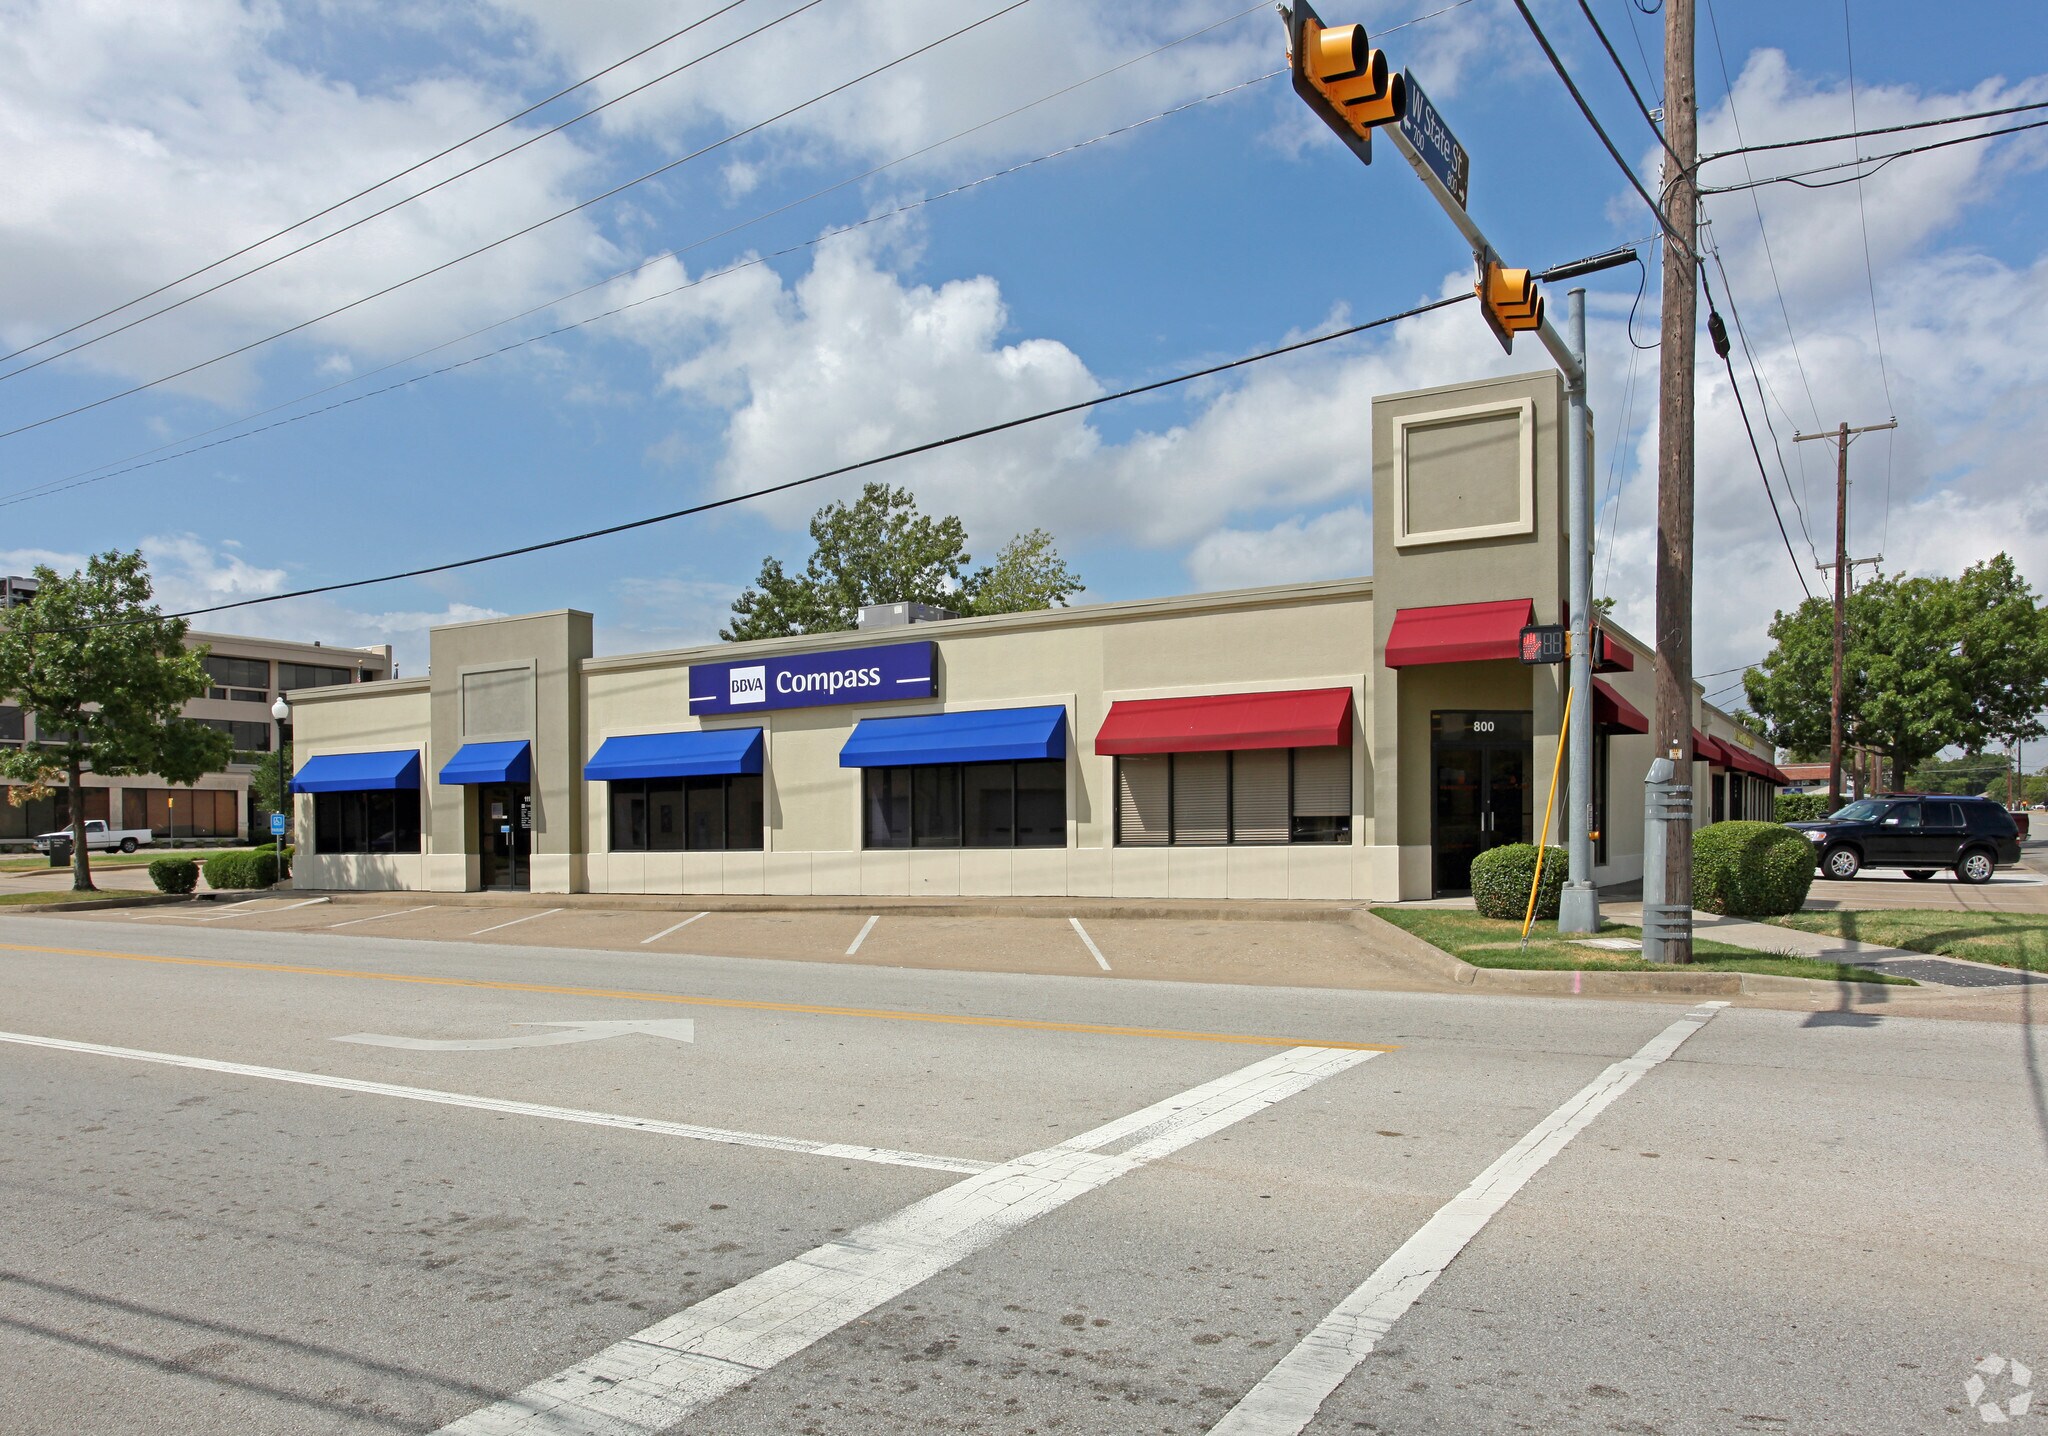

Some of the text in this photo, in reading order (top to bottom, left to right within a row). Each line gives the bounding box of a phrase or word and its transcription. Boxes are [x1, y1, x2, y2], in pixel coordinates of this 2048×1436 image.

[1412, 84, 1463, 179] W State St
[1413, 125, 1425, 151] 700
[1446, 170, 1458, 194] 800
[731, 667, 881, 695] BBVA Compass
[1473, 721, 1495, 732] 800
